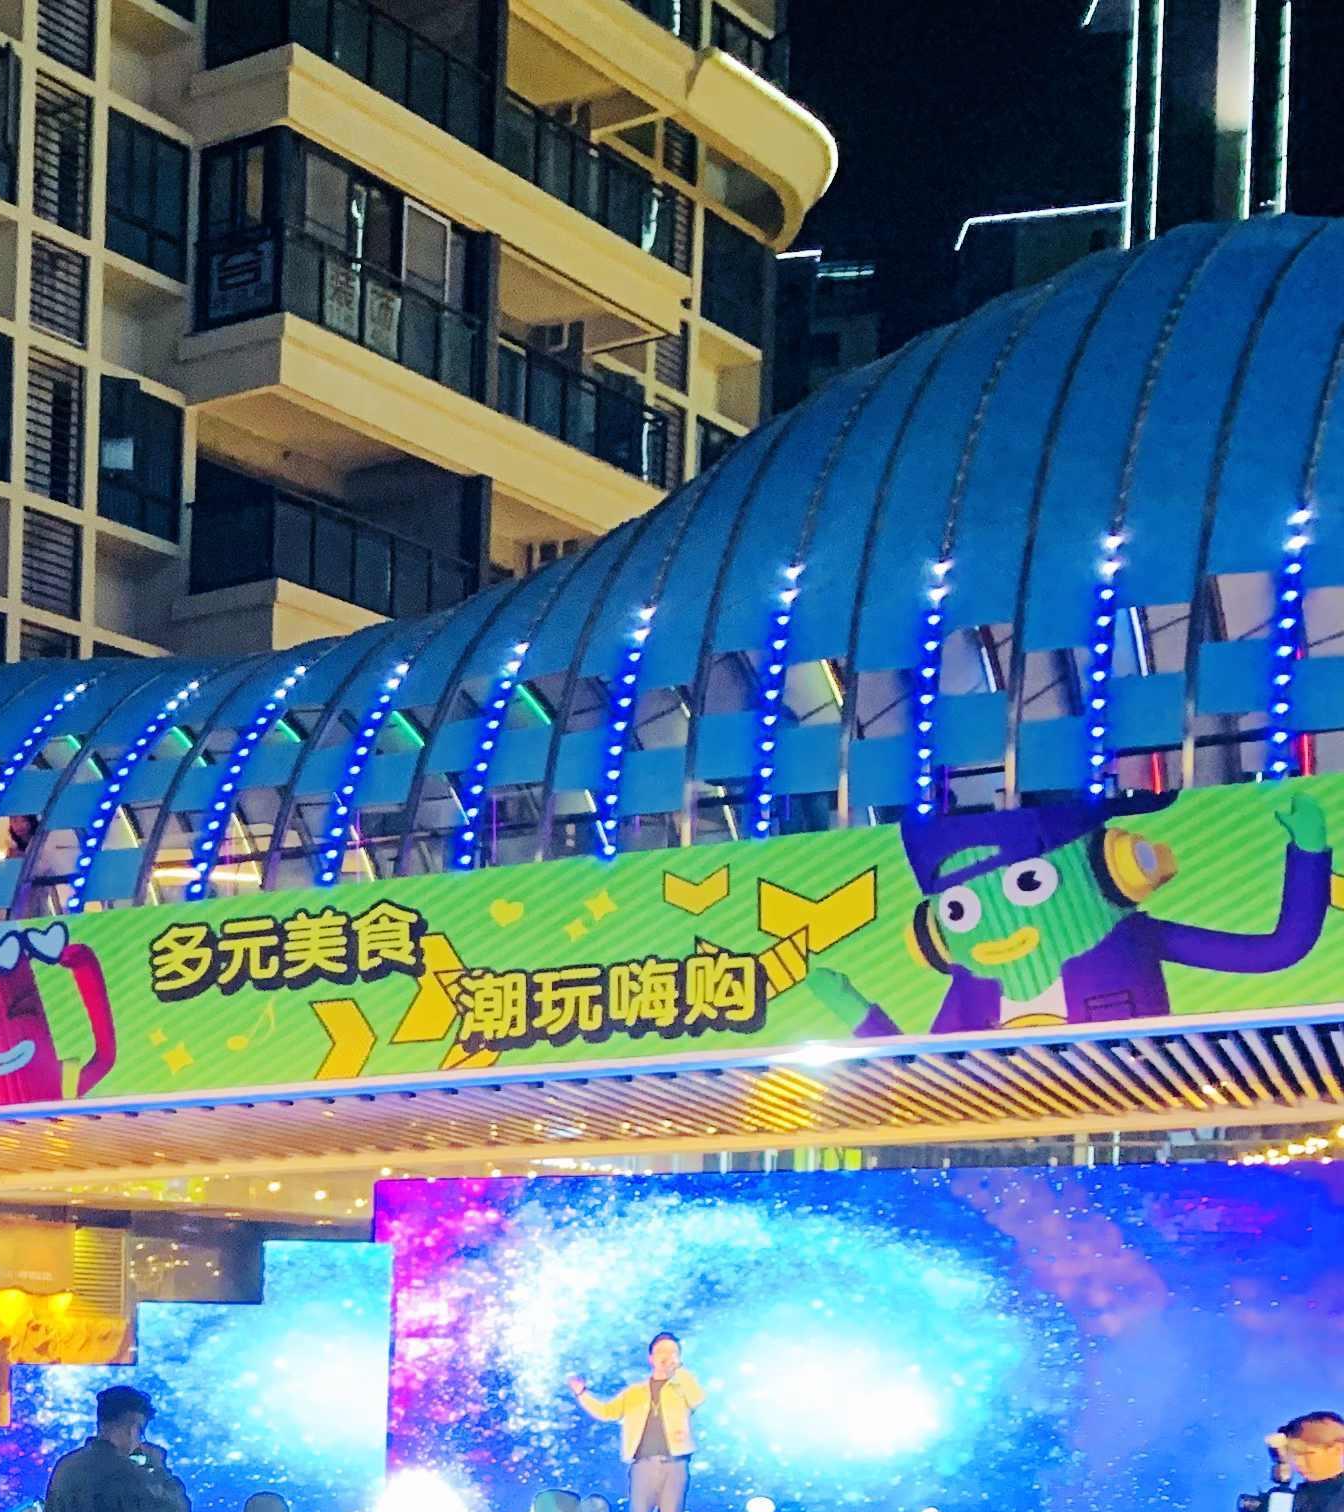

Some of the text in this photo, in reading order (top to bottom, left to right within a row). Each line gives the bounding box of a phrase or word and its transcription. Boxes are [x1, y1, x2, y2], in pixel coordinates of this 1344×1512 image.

[151, 900, 420, 992] 多元美食
[457, 952, 758, 1041] 潮玩嗨购
